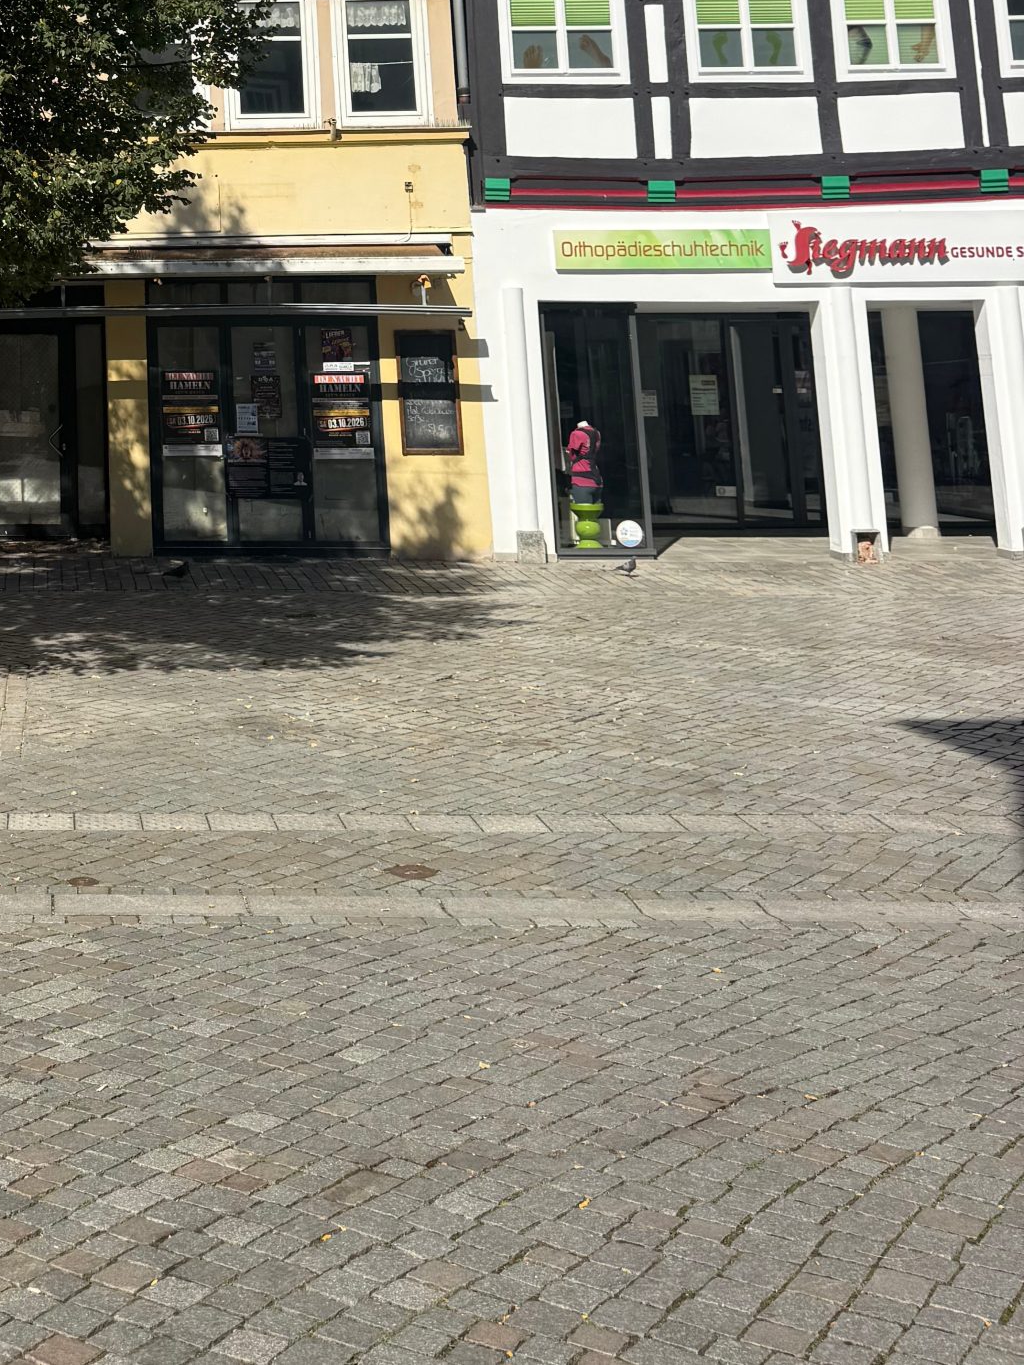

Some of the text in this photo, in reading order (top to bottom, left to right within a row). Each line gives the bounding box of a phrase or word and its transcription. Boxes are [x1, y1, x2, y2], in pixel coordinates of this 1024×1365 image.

[561, 240, 766, 260] Orthopädieschuhtechnik
[787, 226, 950, 274] Siegmann
[950, 246, 1013, 258] GESUNDE
[170, 381, 211, 390] HAMELN
[319, 384, 361, 392] HAMELN
[177, 414, 214, 426] 03.10.2026
[327, 417, 365, 428] 03.10.2026
